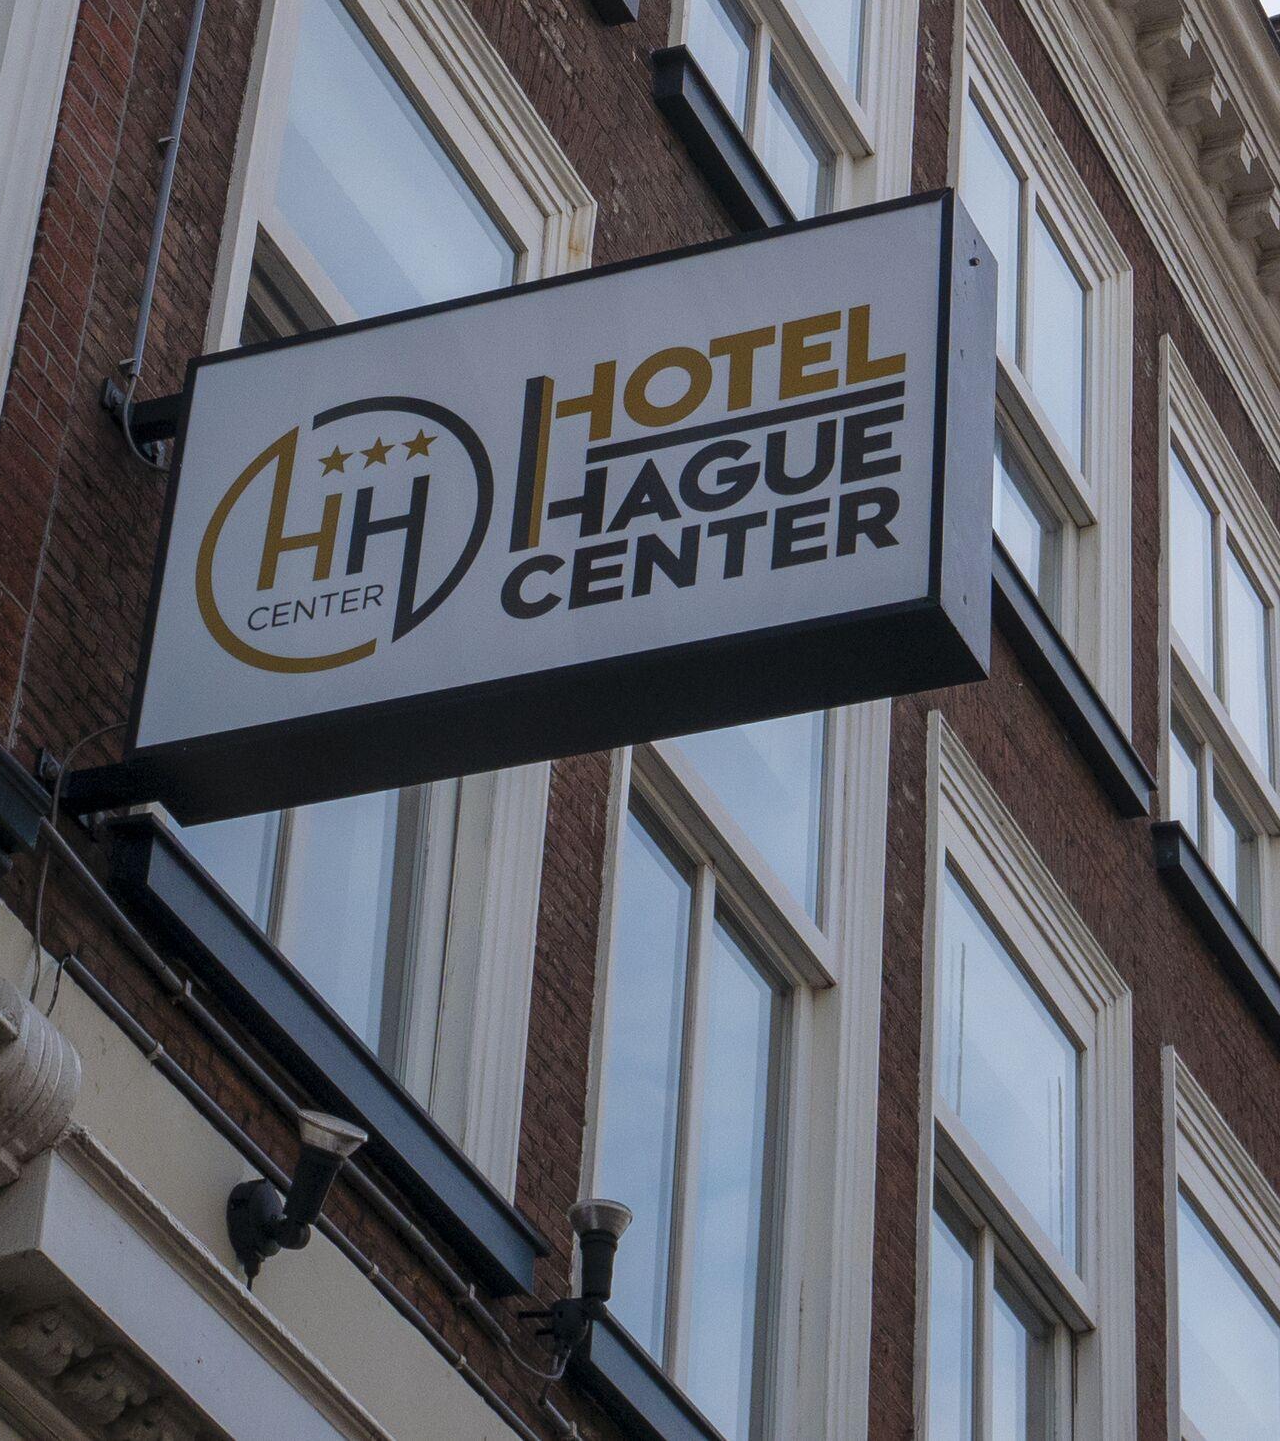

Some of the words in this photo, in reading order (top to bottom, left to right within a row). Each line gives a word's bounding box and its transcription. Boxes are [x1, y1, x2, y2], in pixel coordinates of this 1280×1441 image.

[515, 304, 907, 450] HOTEL
[510, 404, 905, 546] HAGUE
[248, 584, 384, 632] CENTER
[501, 487, 901, 620] CENTER
